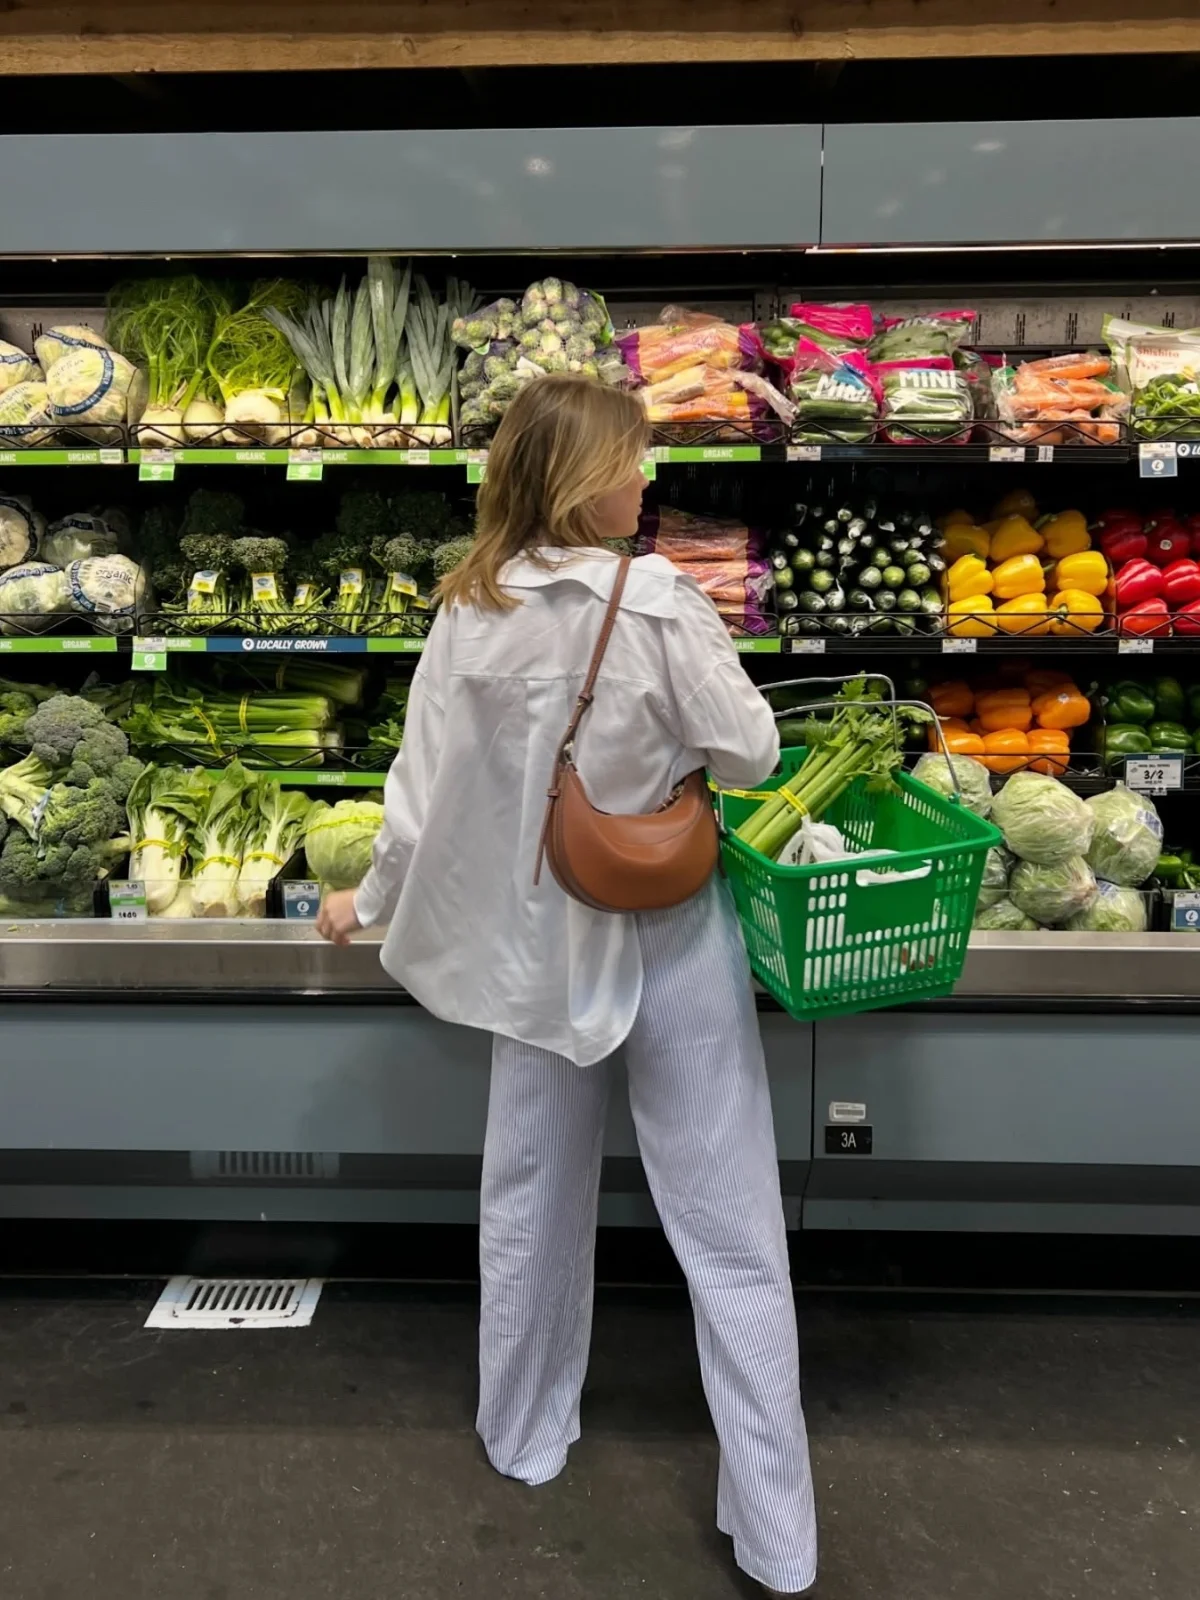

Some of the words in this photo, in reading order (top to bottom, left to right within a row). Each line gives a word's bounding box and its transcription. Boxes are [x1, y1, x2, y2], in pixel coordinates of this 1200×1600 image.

[899, 371, 957, 389] MINI
[67, 452, 97, 462] ORGANIC
[236, 452, 266, 461] ORGANIC
[703, 449, 733, 459] ORGANIC
[96, 568, 133, 585] organic
[62, 639, 92, 649] ORGANIC
[256, 639, 293, 650] LOCALLY
[294, 639, 328, 650] GROWN
[1144, 770, 1164, 780] 3/2
[841, 1132, 857, 1148] 3A
